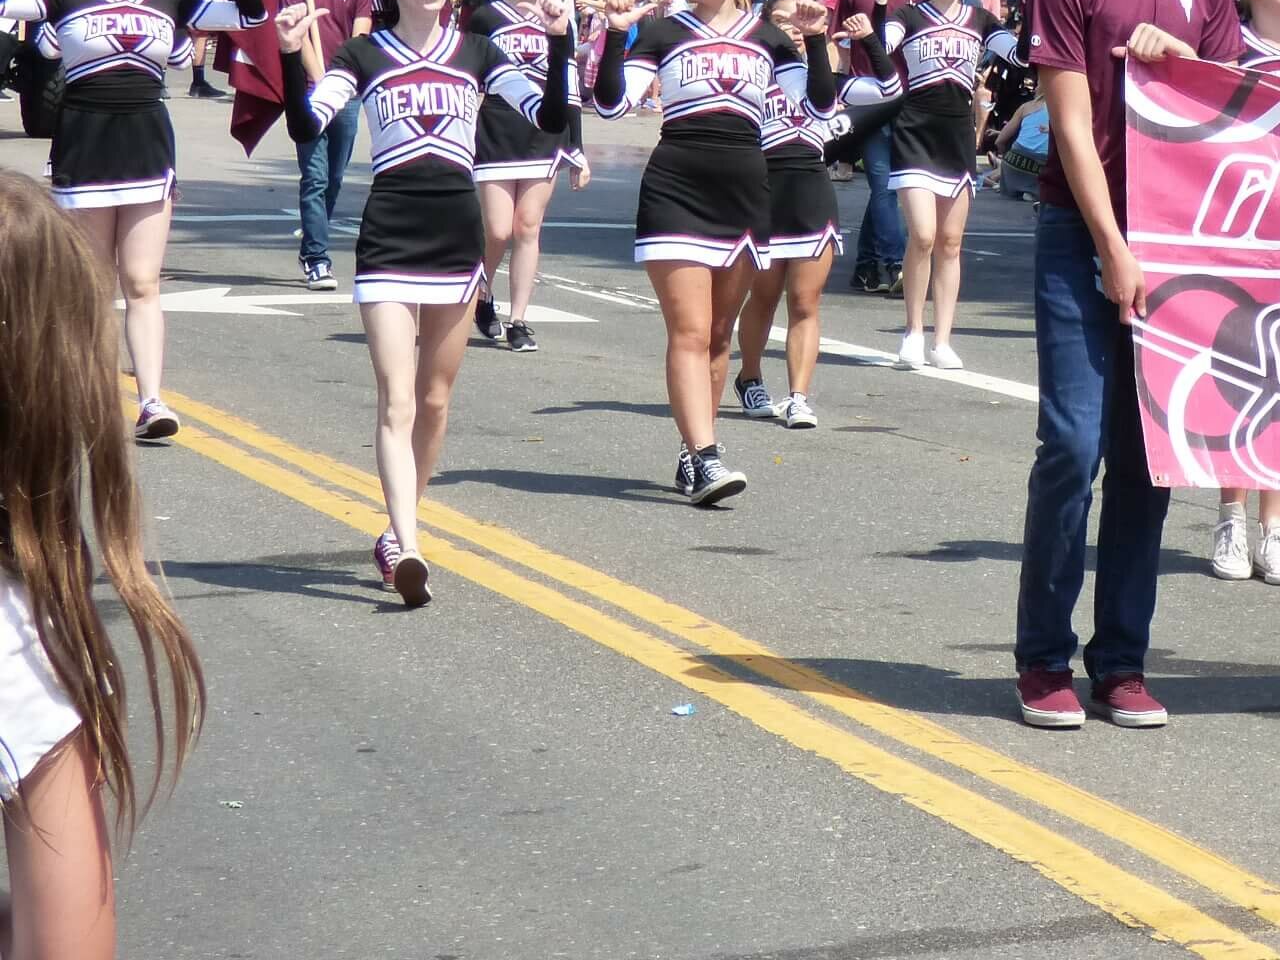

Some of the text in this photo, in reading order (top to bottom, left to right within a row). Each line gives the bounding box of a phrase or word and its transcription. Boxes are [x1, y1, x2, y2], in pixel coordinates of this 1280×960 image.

[84, 13, 170, 46] DEMONS
[498, 34, 549, 54] DEMO
[919, 36, 981, 67] DEMONS
[680, 51, 772, 90] DEMONS
[376, 82, 480, 131] DEMONS
[761, 94, 804, 125] DEM
